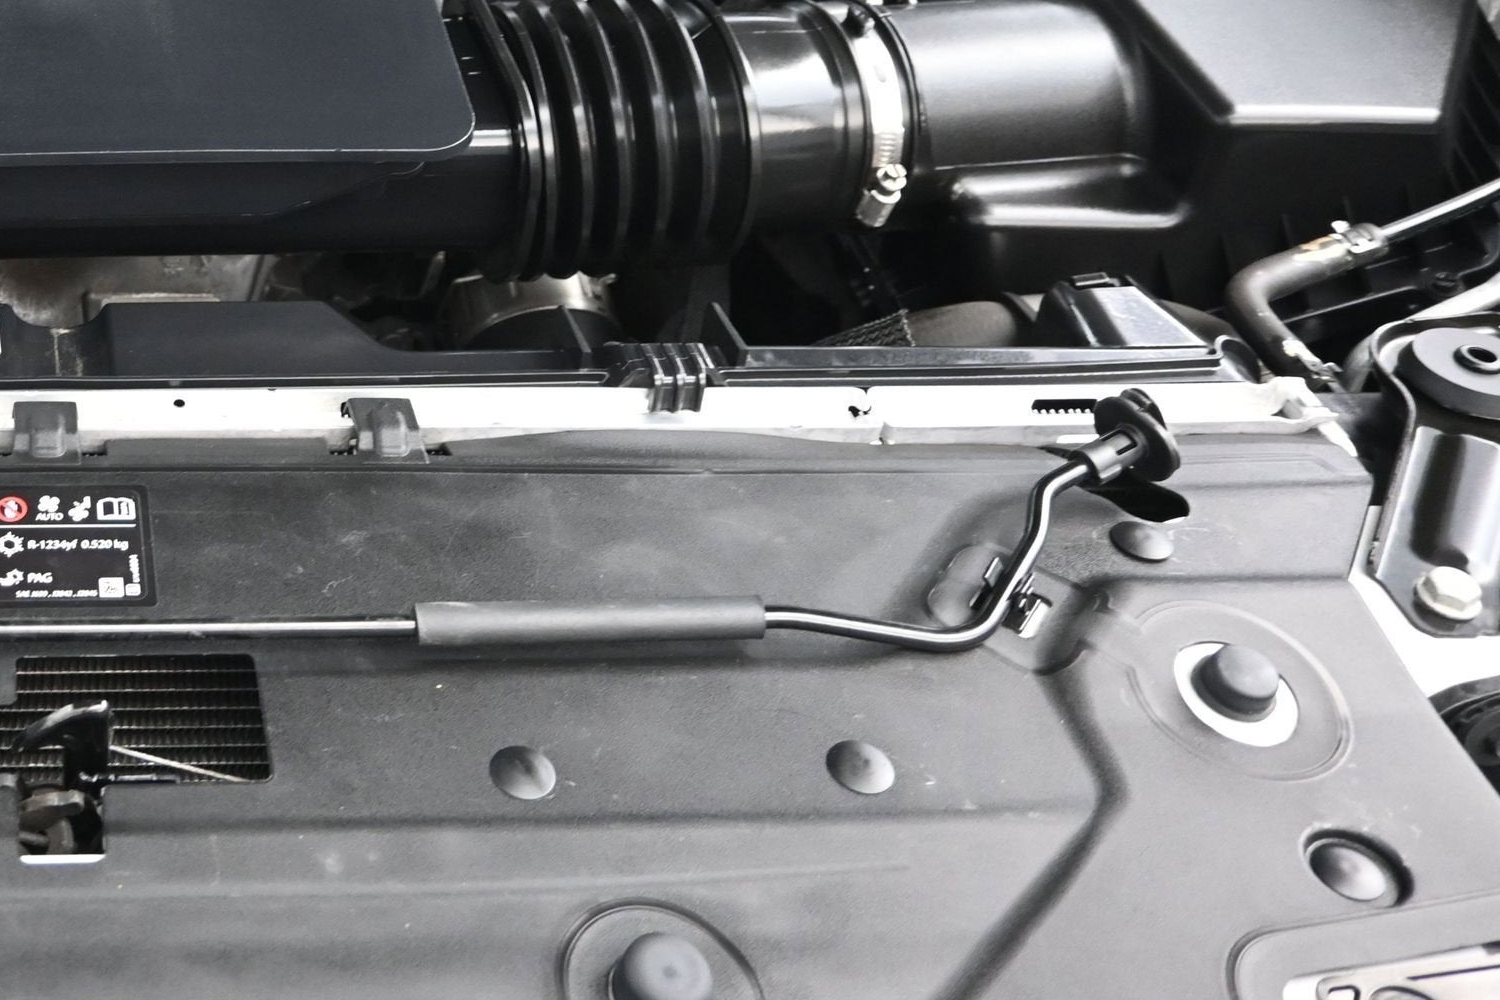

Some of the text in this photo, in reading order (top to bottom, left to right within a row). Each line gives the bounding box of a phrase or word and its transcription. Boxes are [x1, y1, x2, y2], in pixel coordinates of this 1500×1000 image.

[35, 512, 64, 521] AUTO
[26, 538, 129, 551] R-1234yf 0.520 kg
[26, 572, 53, 583] PAG
